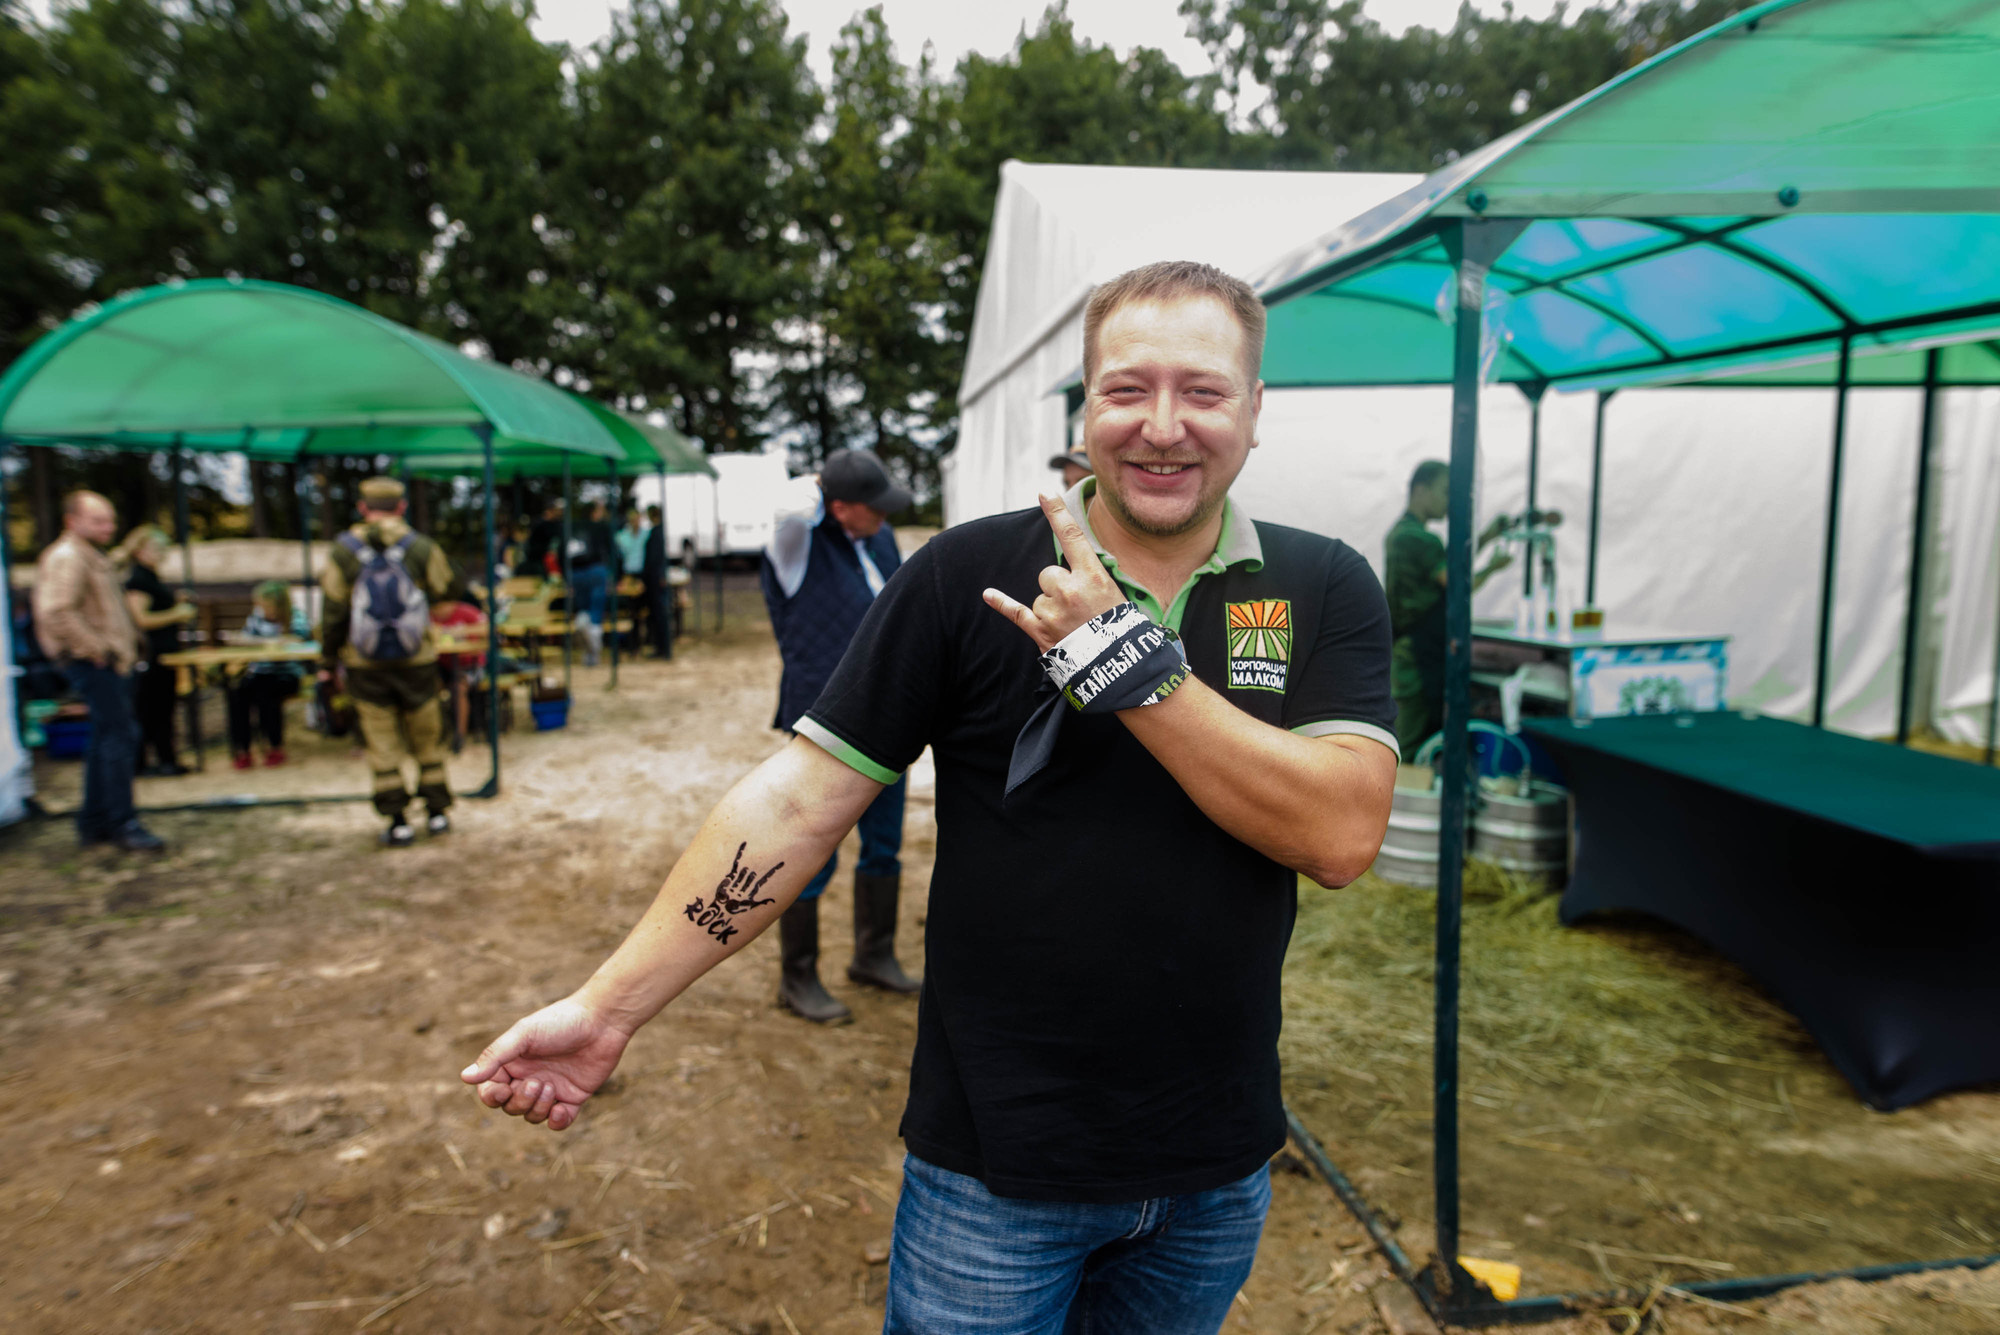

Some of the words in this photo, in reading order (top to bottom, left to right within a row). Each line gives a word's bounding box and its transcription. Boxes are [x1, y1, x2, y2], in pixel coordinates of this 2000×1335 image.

[1231, 660, 1287, 675] КОРПОРАЦИЯ
[1232, 671, 1285, 690] МАЛКОМ
[683, 896, 739, 945] ROCK
